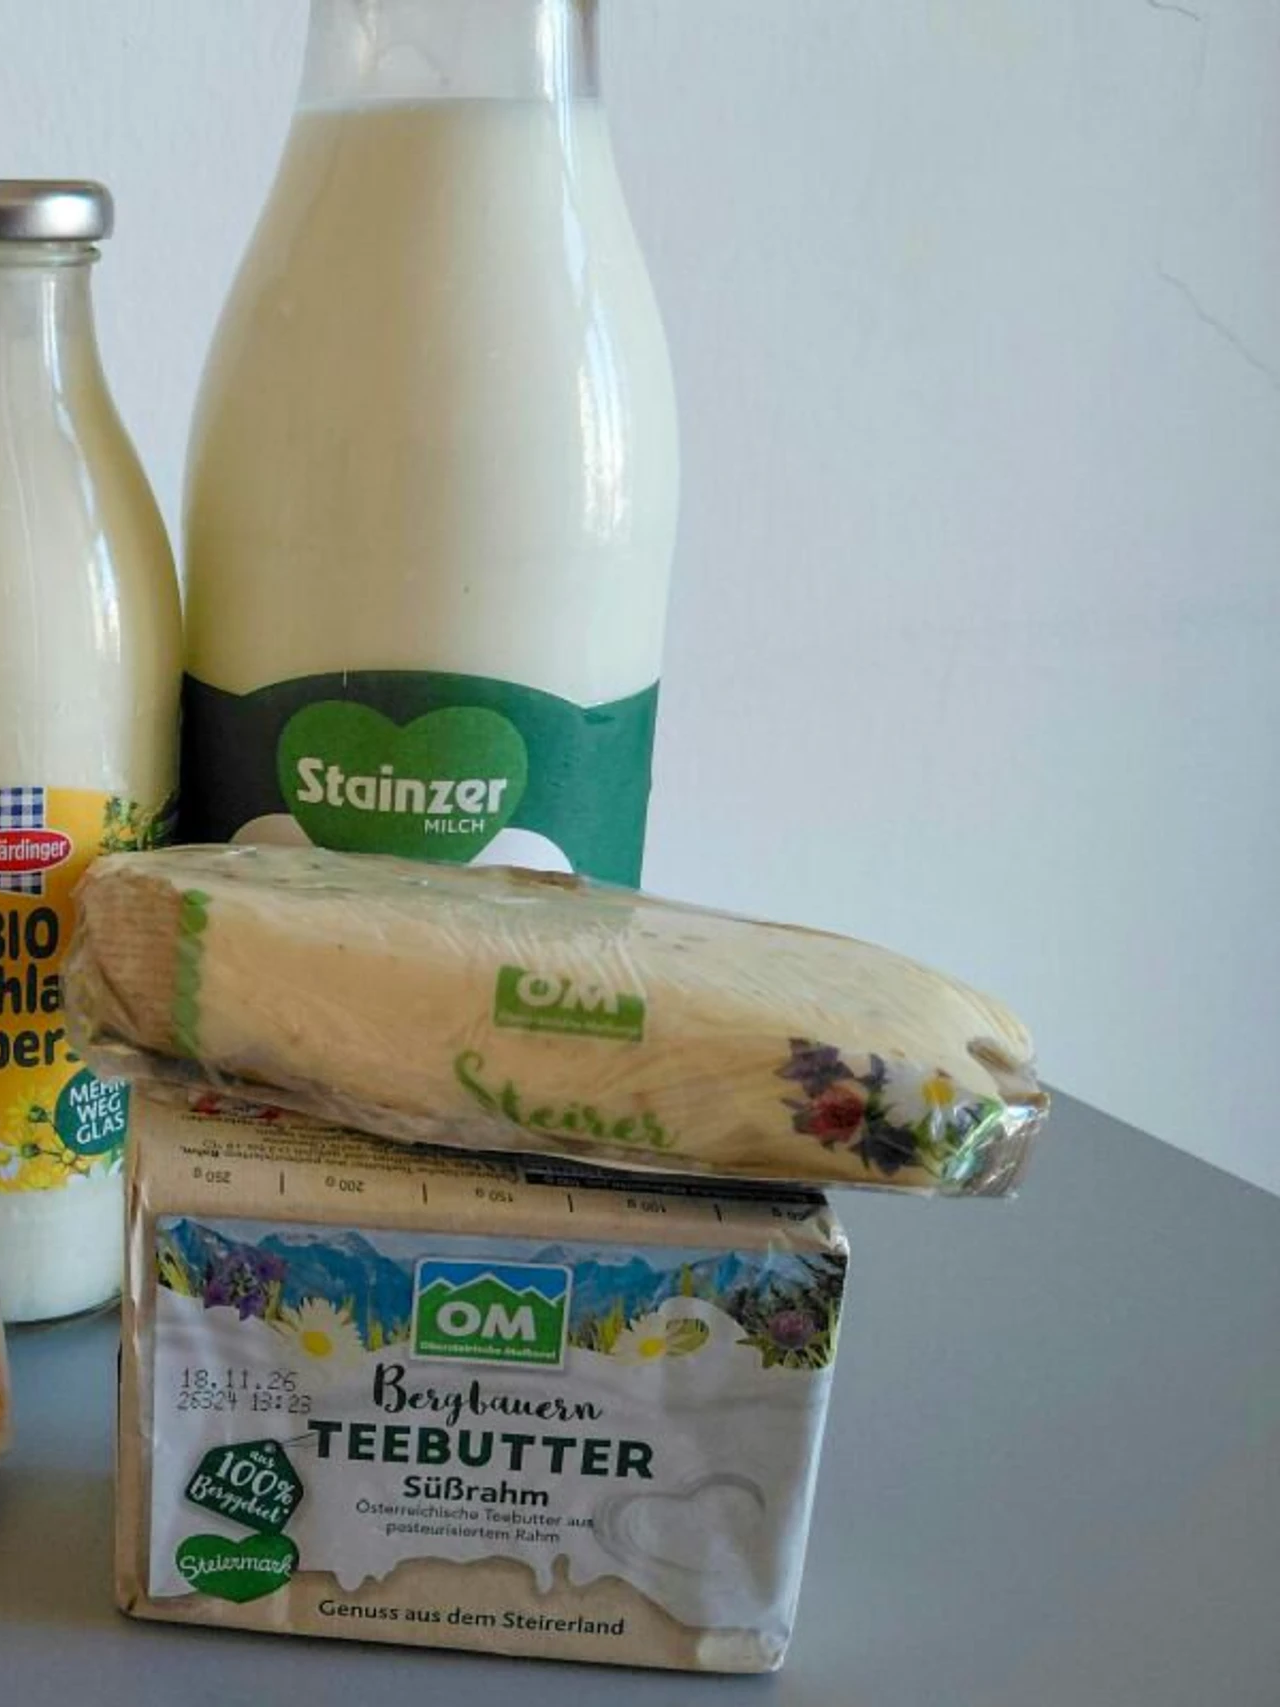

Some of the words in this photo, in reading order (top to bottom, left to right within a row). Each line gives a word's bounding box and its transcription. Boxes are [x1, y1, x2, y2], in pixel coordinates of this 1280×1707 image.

[297, 757, 508, 815] Stainzer
[424, 818, 485, 834] MILCH
[517, 969, 620, 1014] OM
[77, 1093, 121, 1124] WEG
[76, 1112, 124, 1144] GLAS
[436, 1300, 537, 1342] OM
[180, 1367, 298, 1393] 18.11.26
[373, 1362, 603, 1426] Bergbauern
[307, 1418, 654, 1480] TEEBUTTER
[215, 1450, 296, 1505] 100%
[403, 1474, 549, 1508] Süßrahm
[356, 1499, 479, 1522] Österreichische
[484, 1508, 562, 1528] Teebutter
[566, 1517, 595, 1529] aus
[385, 1522, 510, 1543] pasteurisiertem
[515, 1529, 561, 1544] Rahm
[179, 1553, 294, 1581] Steiermark
[318, 1600, 399, 1621] Genuss
[405, 1609, 442, 1624] aus
[446, 1607, 496, 1628] dem
[501, 1612, 625, 1636] Steirerland
